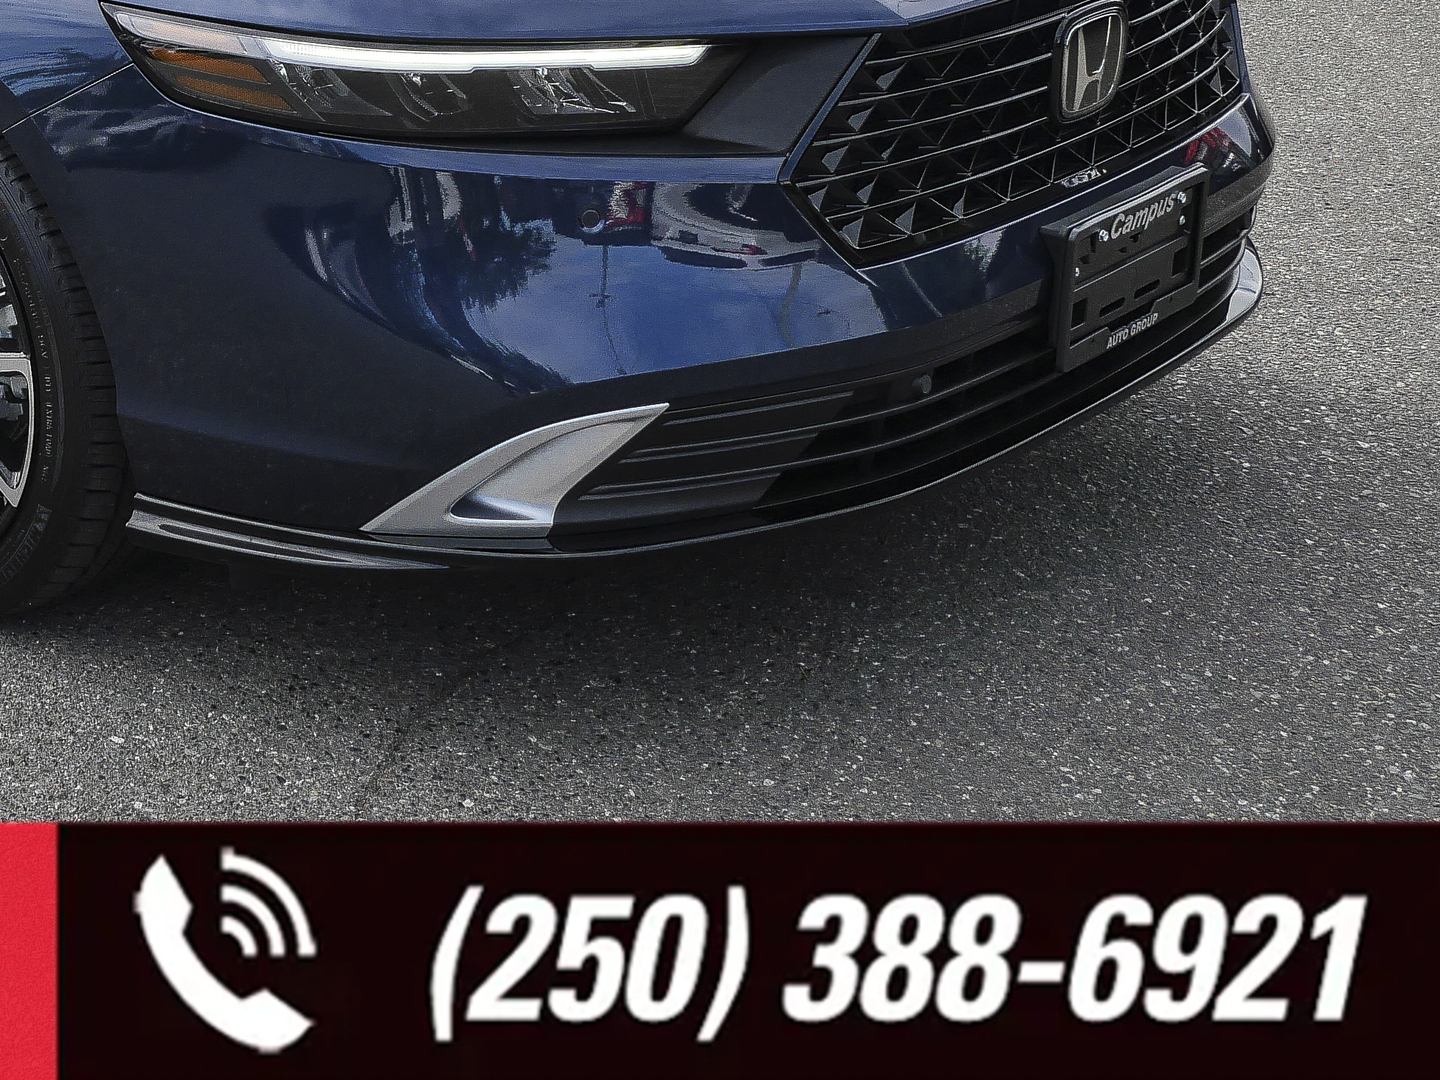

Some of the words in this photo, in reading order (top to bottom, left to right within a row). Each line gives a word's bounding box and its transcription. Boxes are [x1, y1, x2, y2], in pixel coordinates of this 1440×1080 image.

[1110, 192, 1176, 240] Campus
[1106, 327, 1129, 349] AUTO
[1130, 313, 1159, 336] GROUP
